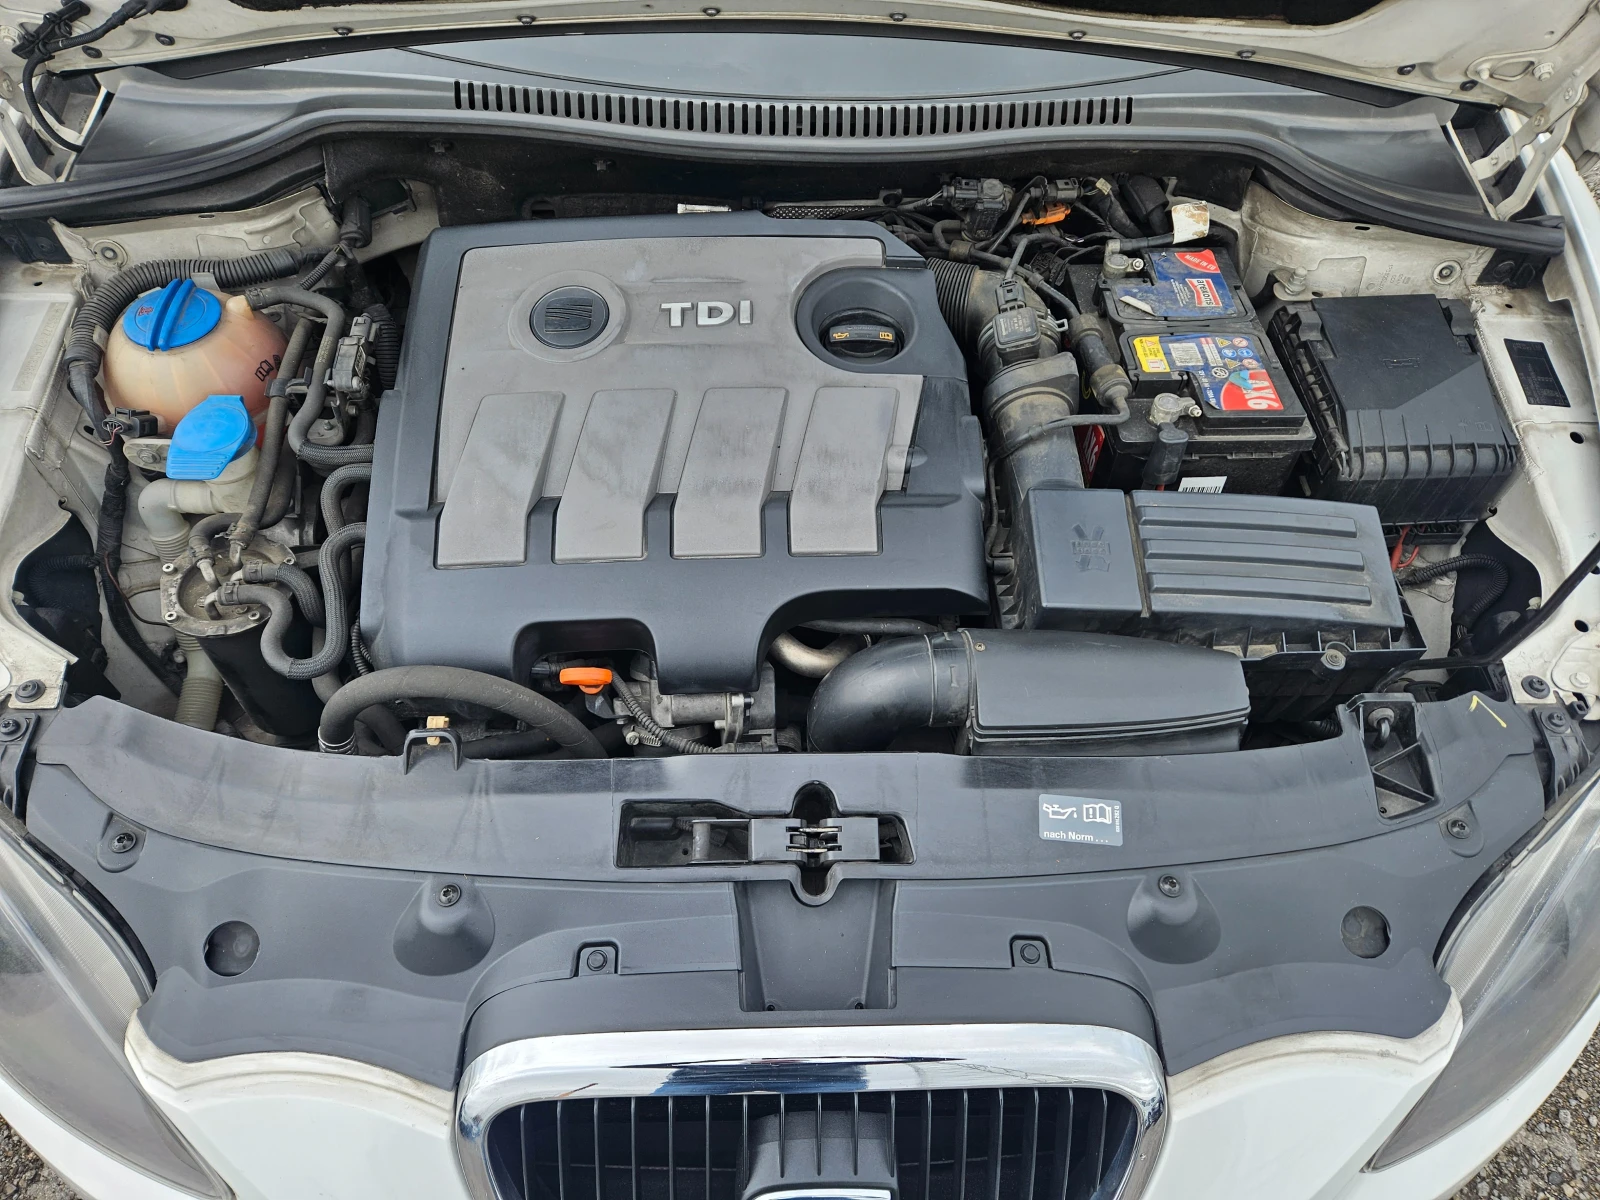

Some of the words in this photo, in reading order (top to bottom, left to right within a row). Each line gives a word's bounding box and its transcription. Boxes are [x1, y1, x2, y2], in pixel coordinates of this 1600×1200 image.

[1184, 254, 1201, 263] MADE
[1196, 279, 1214, 306] arexons
[660, 299, 753, 329] TDI
[1241, 378, 1279, 410] AX6
[1043, 830, 1066, 840] nach
[1068, 831, 1094, 842] Norm
